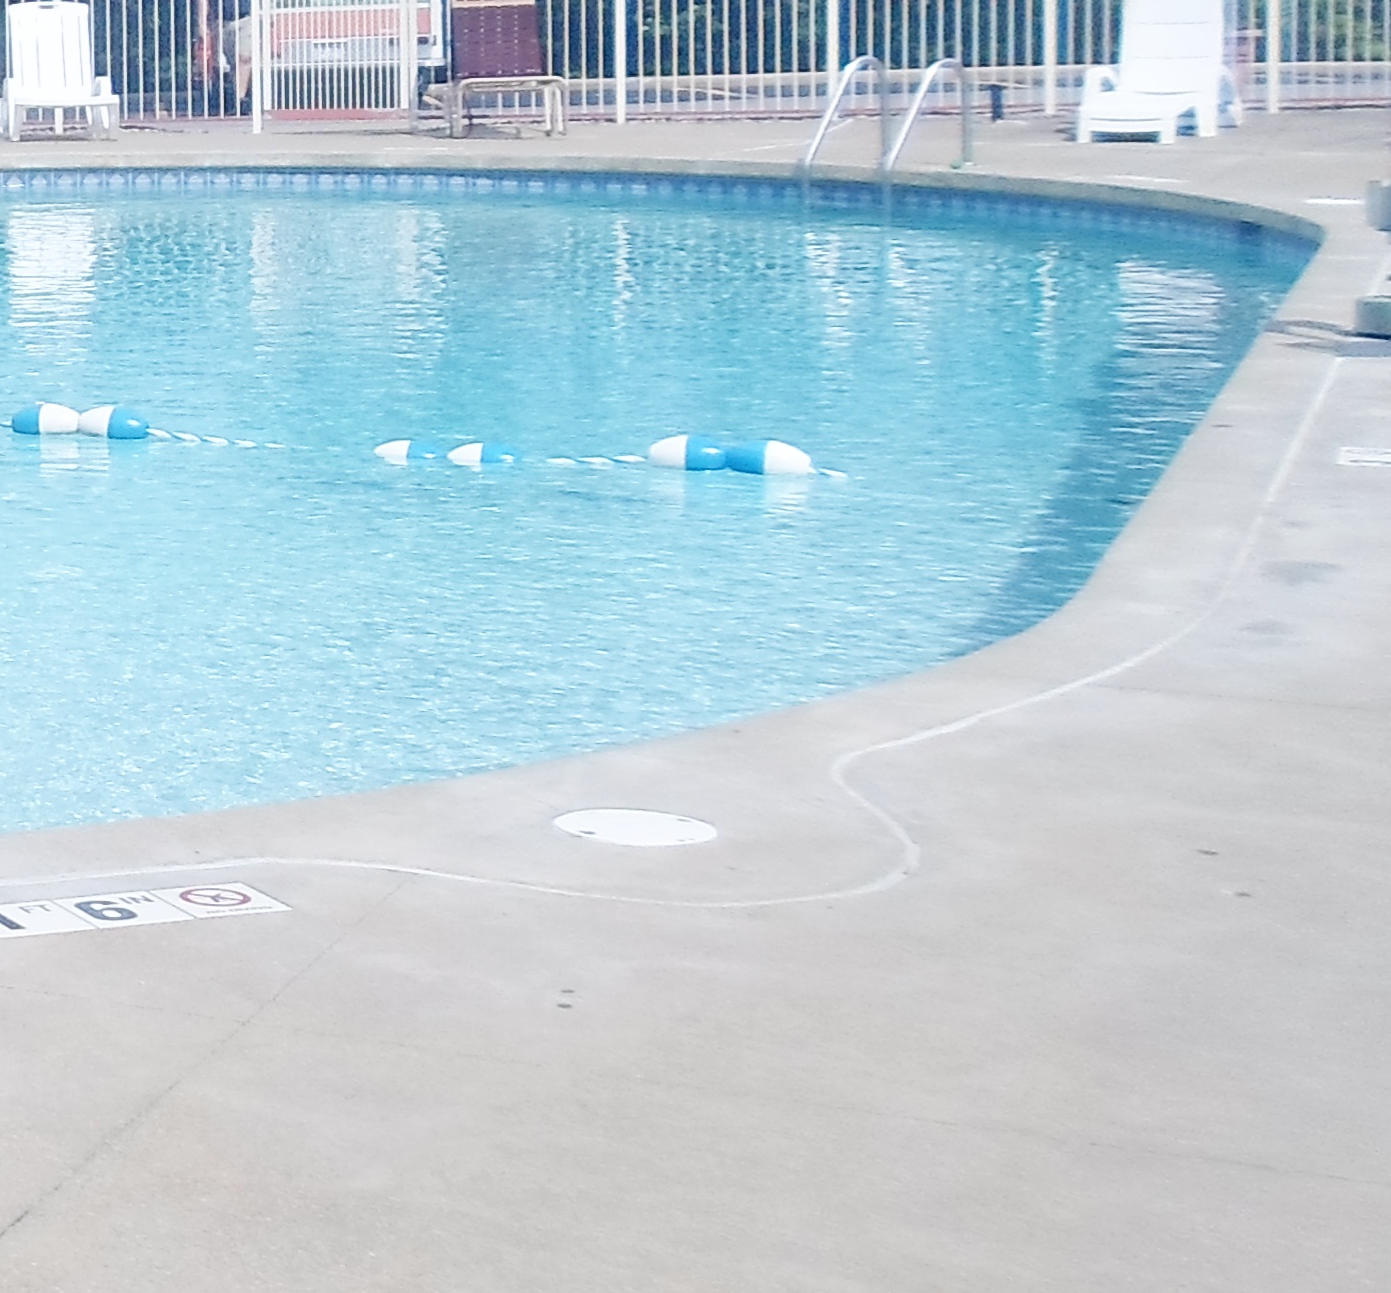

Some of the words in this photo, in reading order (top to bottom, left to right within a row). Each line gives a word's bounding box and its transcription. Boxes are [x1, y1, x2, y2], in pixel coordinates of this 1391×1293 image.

[18, 904, 52, 914] FT
[73, 900, 139, 921] 6
[119, 895, 155, 905] IN
